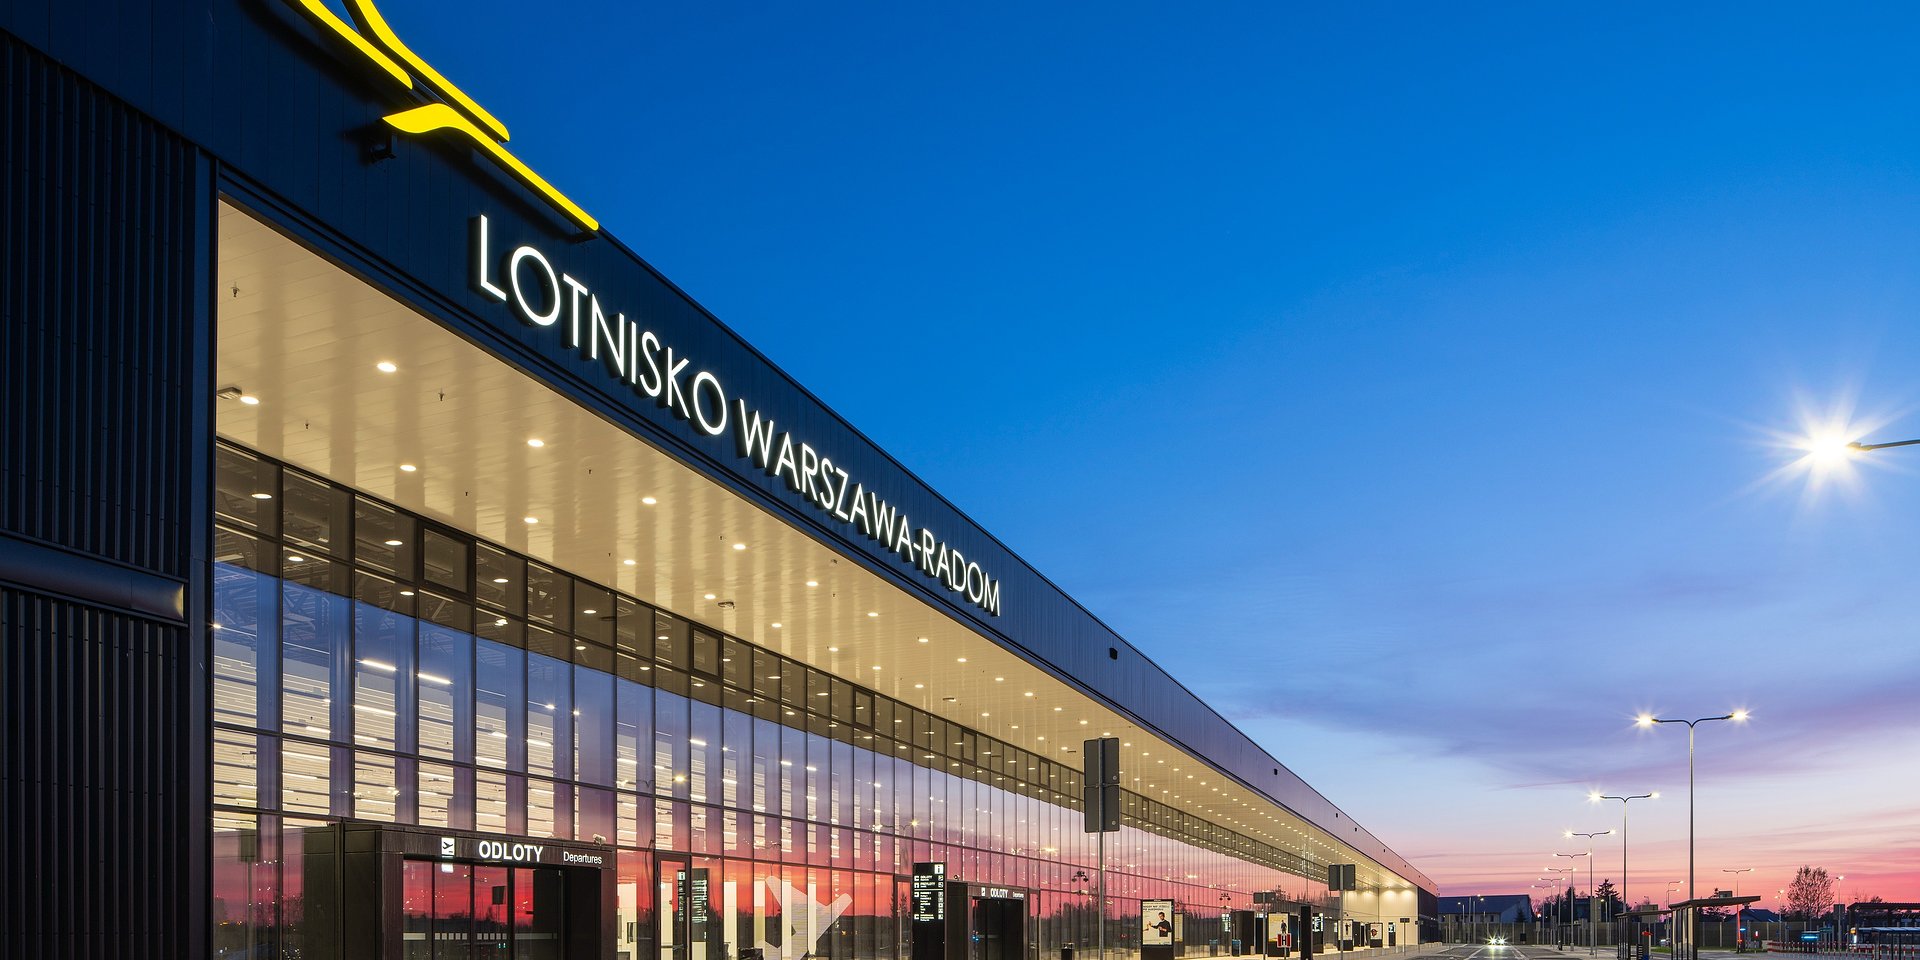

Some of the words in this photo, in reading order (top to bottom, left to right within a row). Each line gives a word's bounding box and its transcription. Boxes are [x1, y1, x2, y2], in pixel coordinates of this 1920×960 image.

[480, 214, 727, 435] LOTNISKO
[739, 398, 1000, 617] WARSZAWA-RADOM
[478, 841, 543, 862] ODLOTY
[563, 851, 602, 865] Departures
[1281, 934, 1287, 946] H
